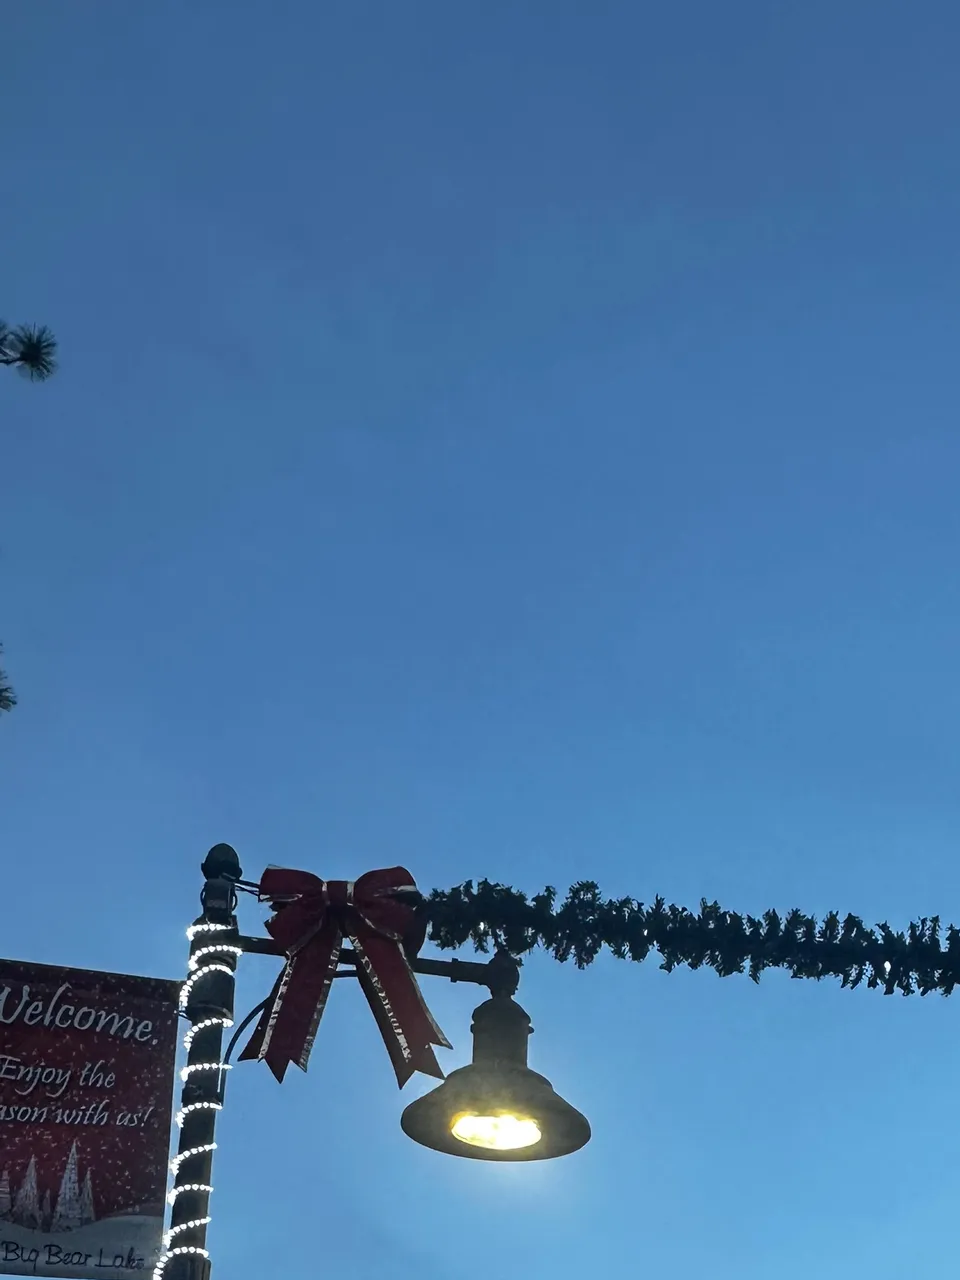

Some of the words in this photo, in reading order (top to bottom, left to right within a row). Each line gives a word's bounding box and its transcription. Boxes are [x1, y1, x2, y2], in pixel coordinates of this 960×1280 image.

[0, 1054, 72, 1098] Enjoy
[79, 1058, 116, 1088] the
[52, 1099, 109, 1125] with
[116, 1107, 153, 1127] us!
[2, 1241, 40, 1273] Big
[43, 1244, 92, 1266] Bear
[94, 1247, 145, 1270] Lake
